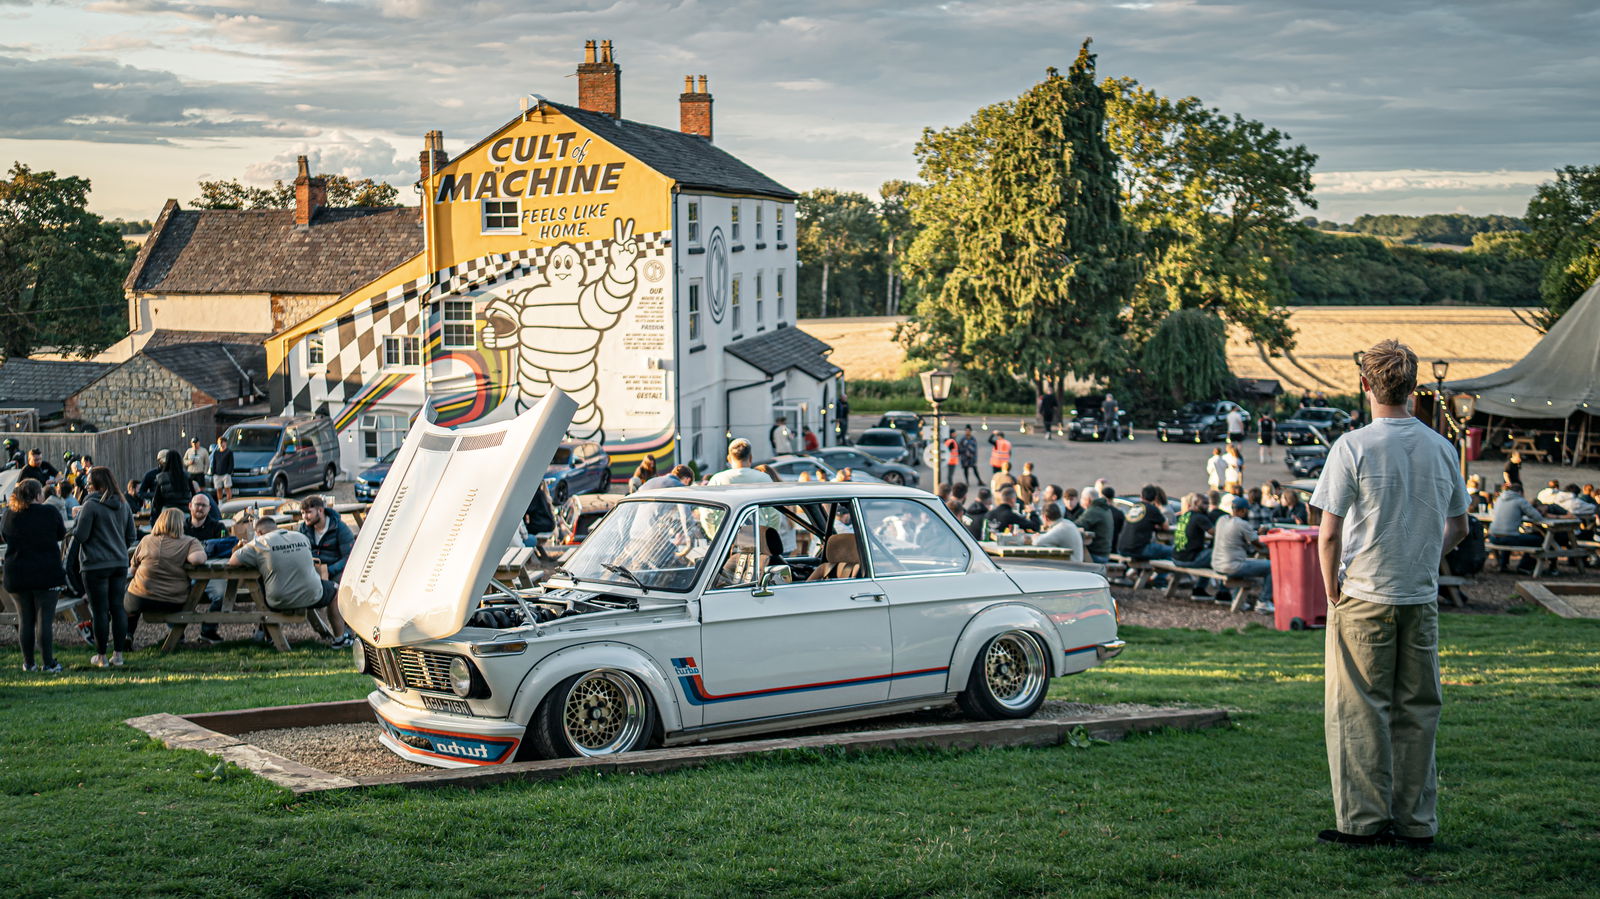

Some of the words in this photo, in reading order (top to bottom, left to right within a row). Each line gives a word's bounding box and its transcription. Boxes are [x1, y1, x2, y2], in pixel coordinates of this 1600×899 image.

[488, 131, 577, 165] CULT
[571, 138, 592, 164] of
[436, 162, 626, 204] MACHINE
[521, 205, 567, 224] FEELS
[572, 203, 609, 220] LIKE
[539, 222, 591, 239] HOME.
[674, 665, 700, 675] turbo
[444, 700, 469, 714] 716N
